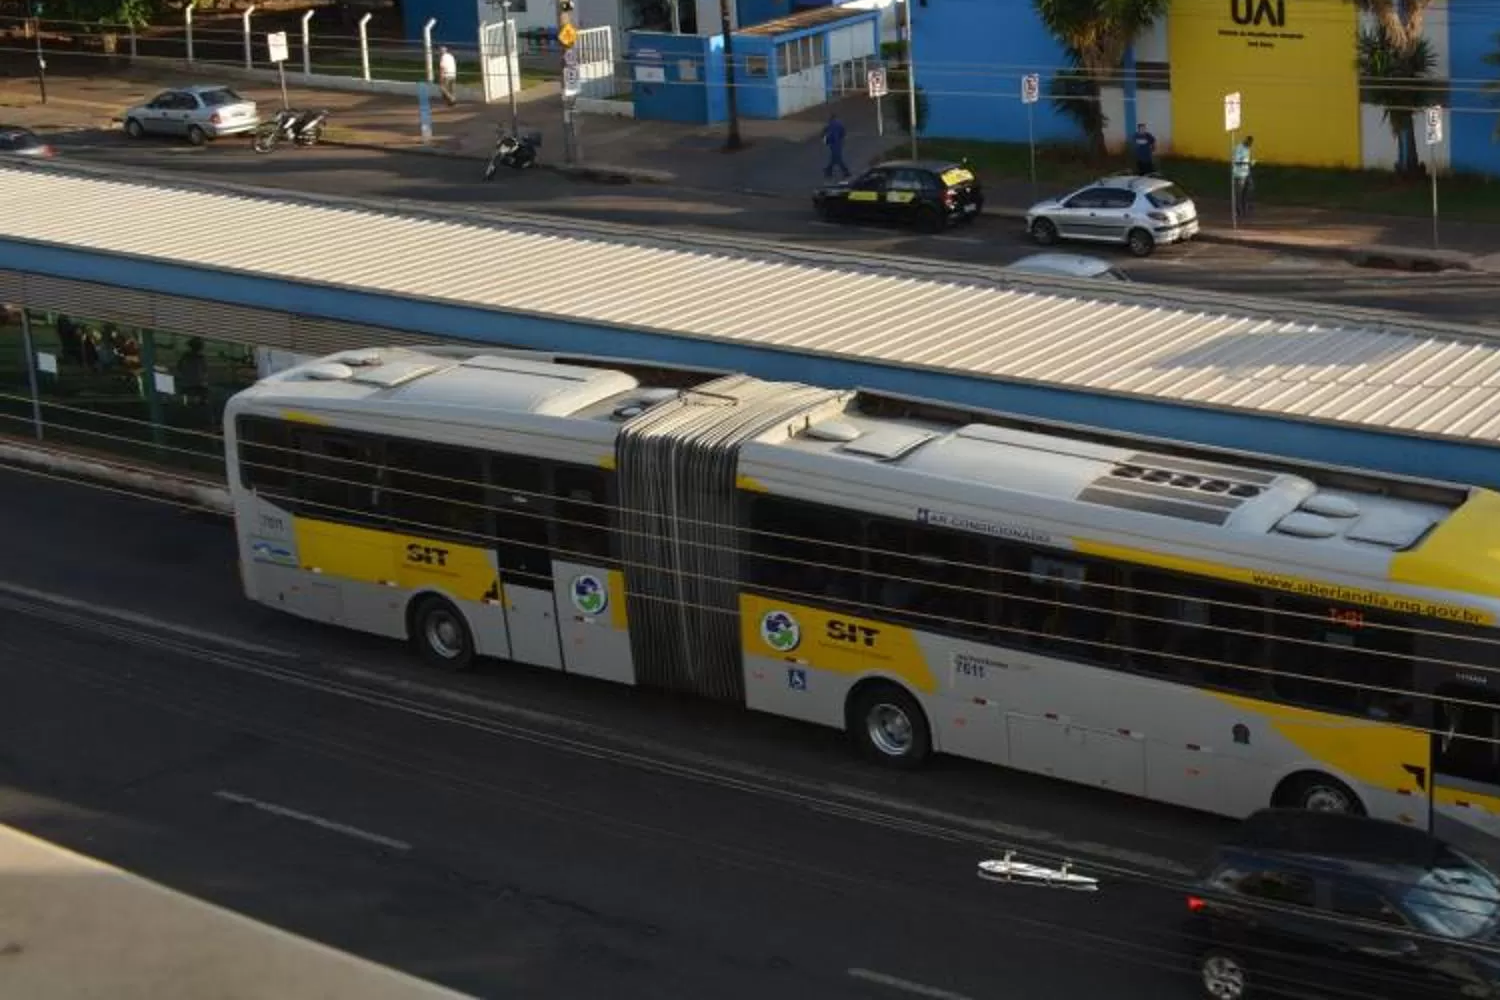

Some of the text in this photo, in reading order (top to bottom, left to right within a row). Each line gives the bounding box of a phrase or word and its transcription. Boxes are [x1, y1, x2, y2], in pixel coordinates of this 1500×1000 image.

[407, 543, 450, 567] SIT
[1252, 572, 1485, 625] www.uberlandia.mg.gov.br
[825, 619, 881, 647] SIT
